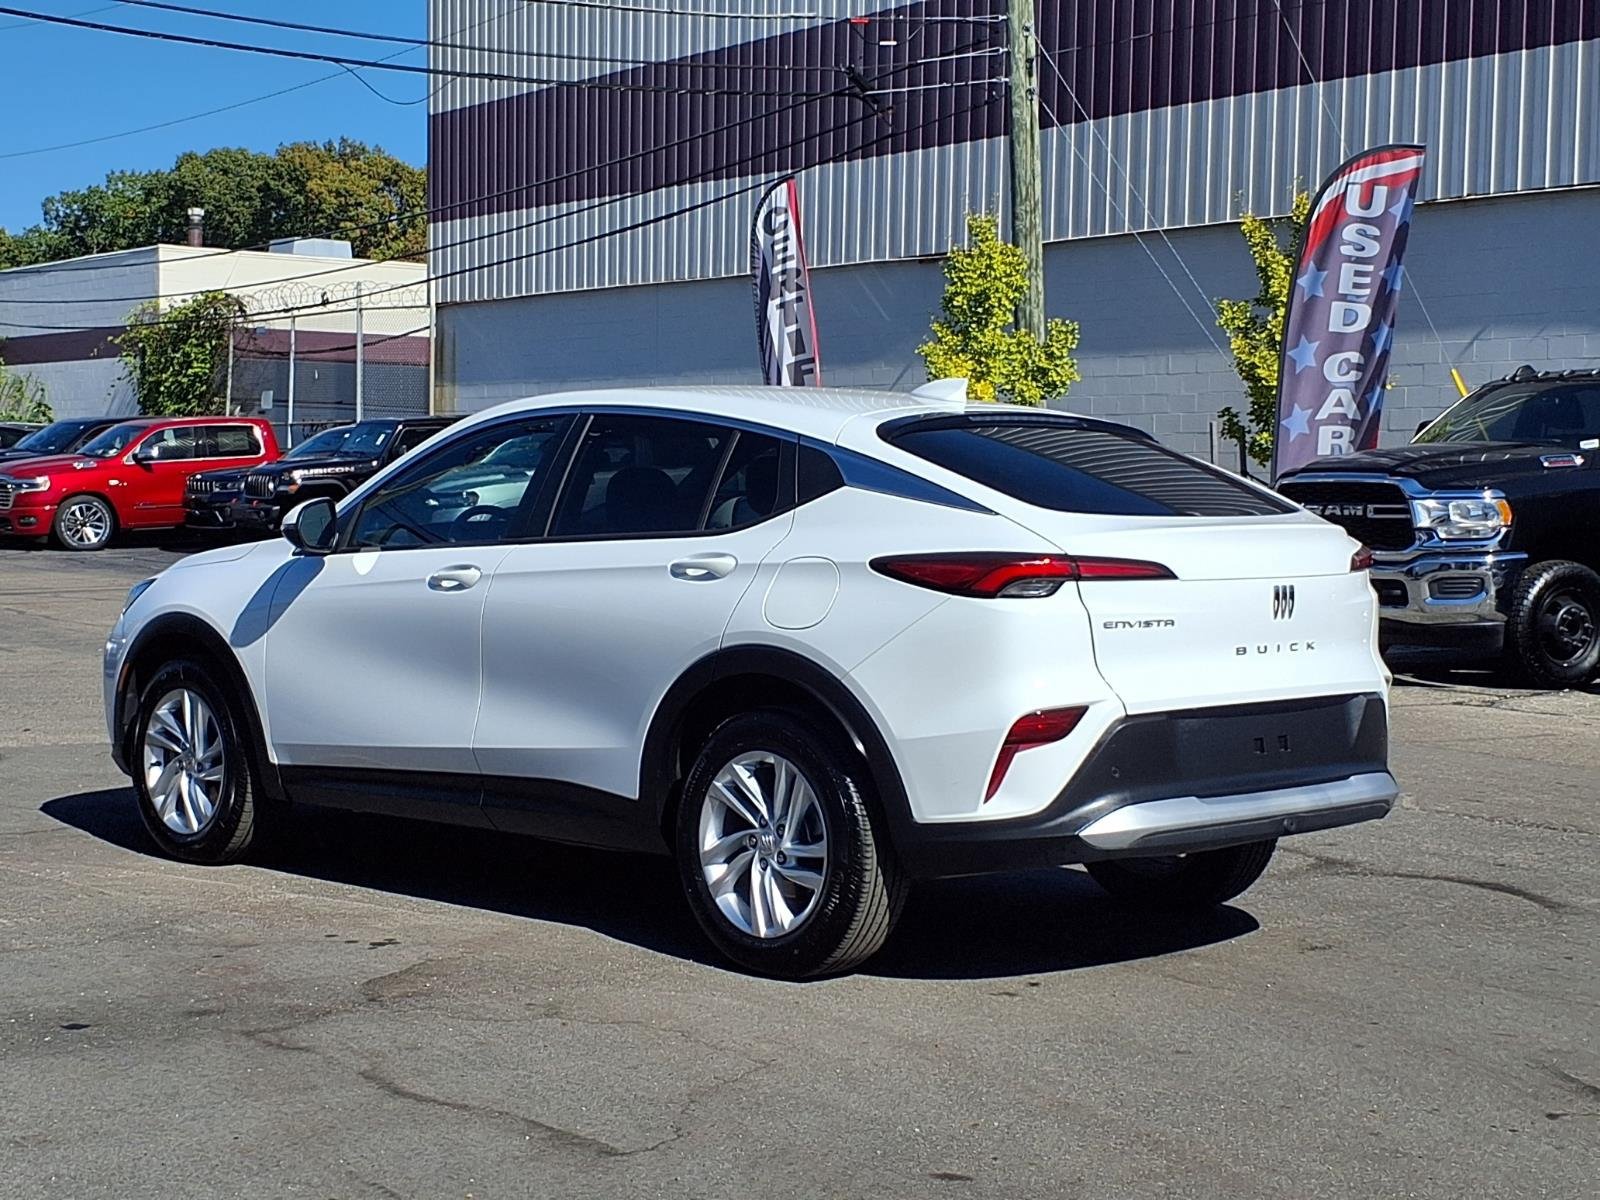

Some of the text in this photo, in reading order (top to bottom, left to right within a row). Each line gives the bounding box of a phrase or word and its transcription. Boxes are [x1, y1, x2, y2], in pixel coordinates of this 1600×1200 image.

[1314, 182, 1389, 456] USED CAR
[293, 466, 355, 477] RUBICON
[1102, 618, 1176, 630] ENVISTA
[1235, 641, 1316, 656] BUICK
